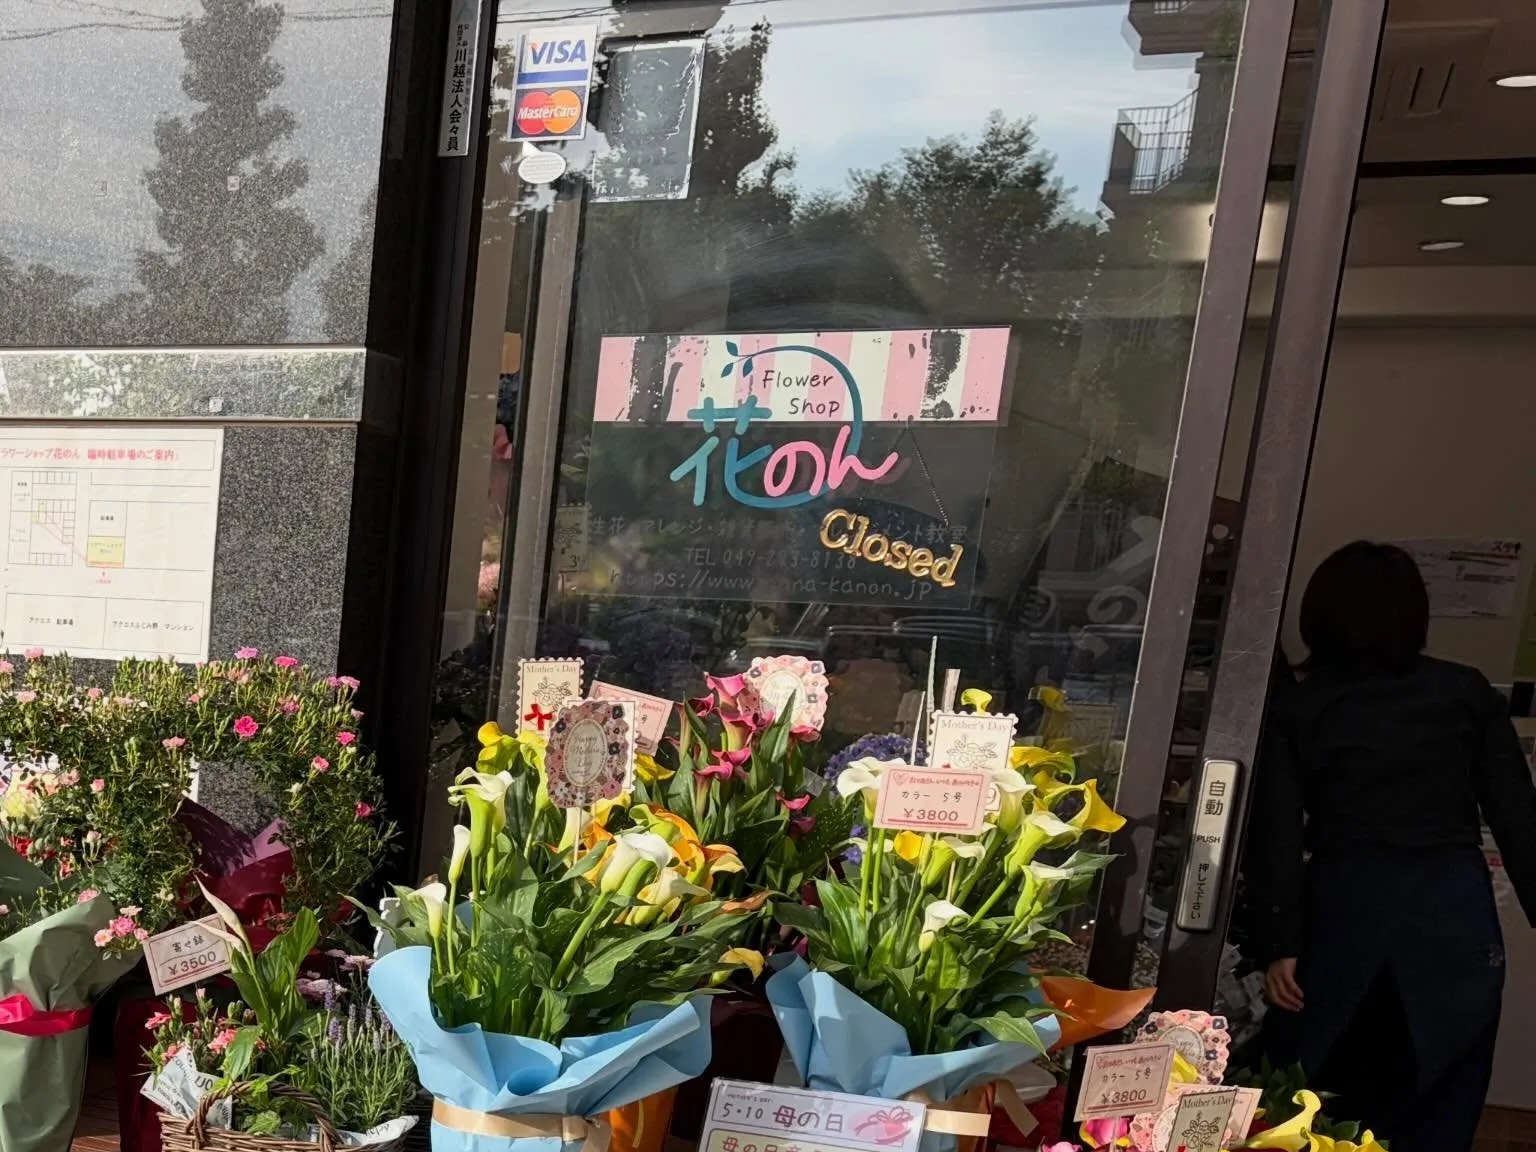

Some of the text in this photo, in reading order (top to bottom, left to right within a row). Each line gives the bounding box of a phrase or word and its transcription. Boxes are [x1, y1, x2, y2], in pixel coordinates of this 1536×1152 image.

[530, 39, 587, 65] VISA
[447, 48, 467, 152] 川越法人会々員
[517, 105, 578, 120] MasterCard
[762, 368, 834, 389] Flower
[788, 396, 841, 417] Shop
[670, 394, 899, 508] 花のん
[684, 547, 716, 567] TEL
[819, 508, 965, 588] Closed
[560, 664, 578, 676] Day
[940, 719, 1009, 732] Mother's Day
[901, 790, 963, 804] カラー 5号
[1204, 779, 1226, 817] 自動
[903, 807, 960, 822] ¥3800
[1196, 834, 1221, 844] PUSH
[1190, 862, 1210, 920] 押して下さい
[167, 951, 218, 976] ¥3500
[1101, 1089, 1147, 1105] ¥3800
[1181, 1094, 1213, 1110] Mother's
[772, 1104, 844, 1133] 母の日
